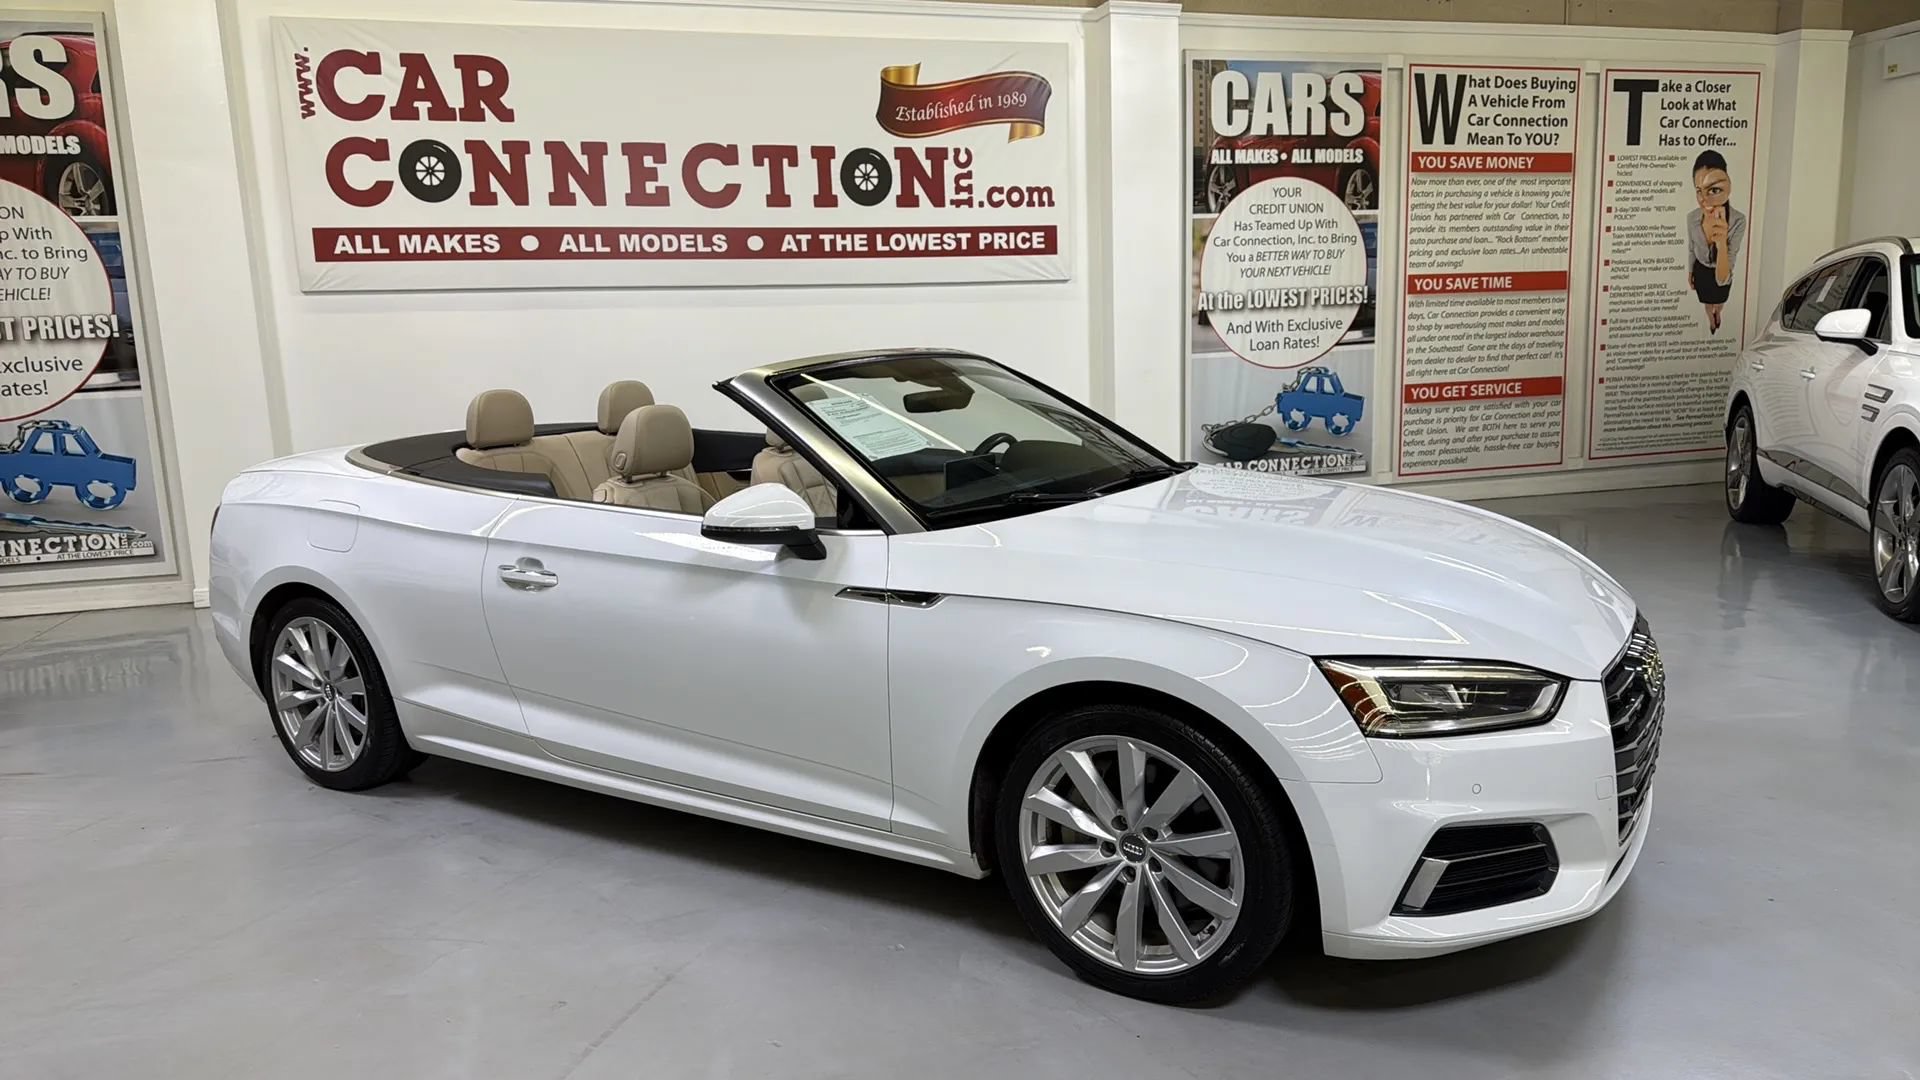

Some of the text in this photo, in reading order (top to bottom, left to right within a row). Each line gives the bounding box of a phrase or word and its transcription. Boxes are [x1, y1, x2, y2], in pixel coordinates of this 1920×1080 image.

[295, 47, 514, 122] www. CAR
[1495, 76, 1527, 89] Does
[1531, 77, 1576, 93] Buying
[1685, 82, 1691, 92] a
[1695, 81, 1731, 93] Closer
[896, 91, 1027, 121] Established in 1989
[1211, 71, 1365, 136] CARS
[1468, 94, 1565, 108] A Vehicle From
[1661, 98, 1736, 111] Look at What
[1468, 114, 1568, 127] Car Connection
[1660, 116, 1747, 128] Car Connection
[1467, 133, 1559, 145] Mean To YOU?
[1659, 134, 1736, 146] Has to Offer...
[1211, 148, 1363, 164] ALL MAKES ALL MODELS
[1418, 156, 1534, 168] YOU SAVE MONEY
[325, 136, 949, 209] CONNECTION
[978, 185, 1054, 207] .com
[1272, 188, 1302, 198] YOUR
[1444, 189, 1482, 199] purchasing
[1490, 189, 1513, 197] vehicle
[1522, 189, 1549, 198] knowing
[1249, 203, 1324, 214] CREDIT UNION
[1411, 202, 1435, 211] getting
[1449, 201, 1463, 209] best
[1465, 201, 1482, 209] value
[1551, 200, 1570, 208] Credit
[1234, 218, 1338, 231] Has Teamed Up With
[13, 227, 52, 240] With
[1214, 233, 1357, 247] Car Connection, Inc. to Bring
[334, 231, 1045, 254] ALL MAKES ALL MODELS AT THE LOWEST PRICE
[22, 248, 39, 259] to
[44, 246, 87, 262] Bring
[1227, 249, 1344, 263] You a BETTER WAY TO BUY
[16, 267, 36, 280] TO
[41, 266, 69, 279] BUY
[1240, 265, 1331, 278] YOUR NEXT VEHICLE!
[1414, 277, 1512, 290] YOU SAVE TIME
[1198, 286, 1368, 311] At the LOWEST PRICES!
[1427, 311, 1439, 319] Car
[1441, 310, 1479, 318] Connection
[1480, 309, 1507, 317] provides
[21, 314, 120, 340] PRICES!
[1227, 318, 1343, 334] And With Exclusive
[1250, 336, 1320, 351] Loan Rates!
[1406, 369, 1415, 377] all
[1416, 369, 1432, 377] right
[1470, 364, 1510, 374] Connection!
[1411, 383, 1522, 399] YOU GET SERVICE
[1403, 418, 1434, 426] purchase
[1443, 416, 1467, 424] priority
[1481, 413, 1492, 421] Car
[1494, 412, 1530, 420] Connection
[1532, 410, 1545, 418] and
[1248, 454, 1346, 472] CONNECTION
